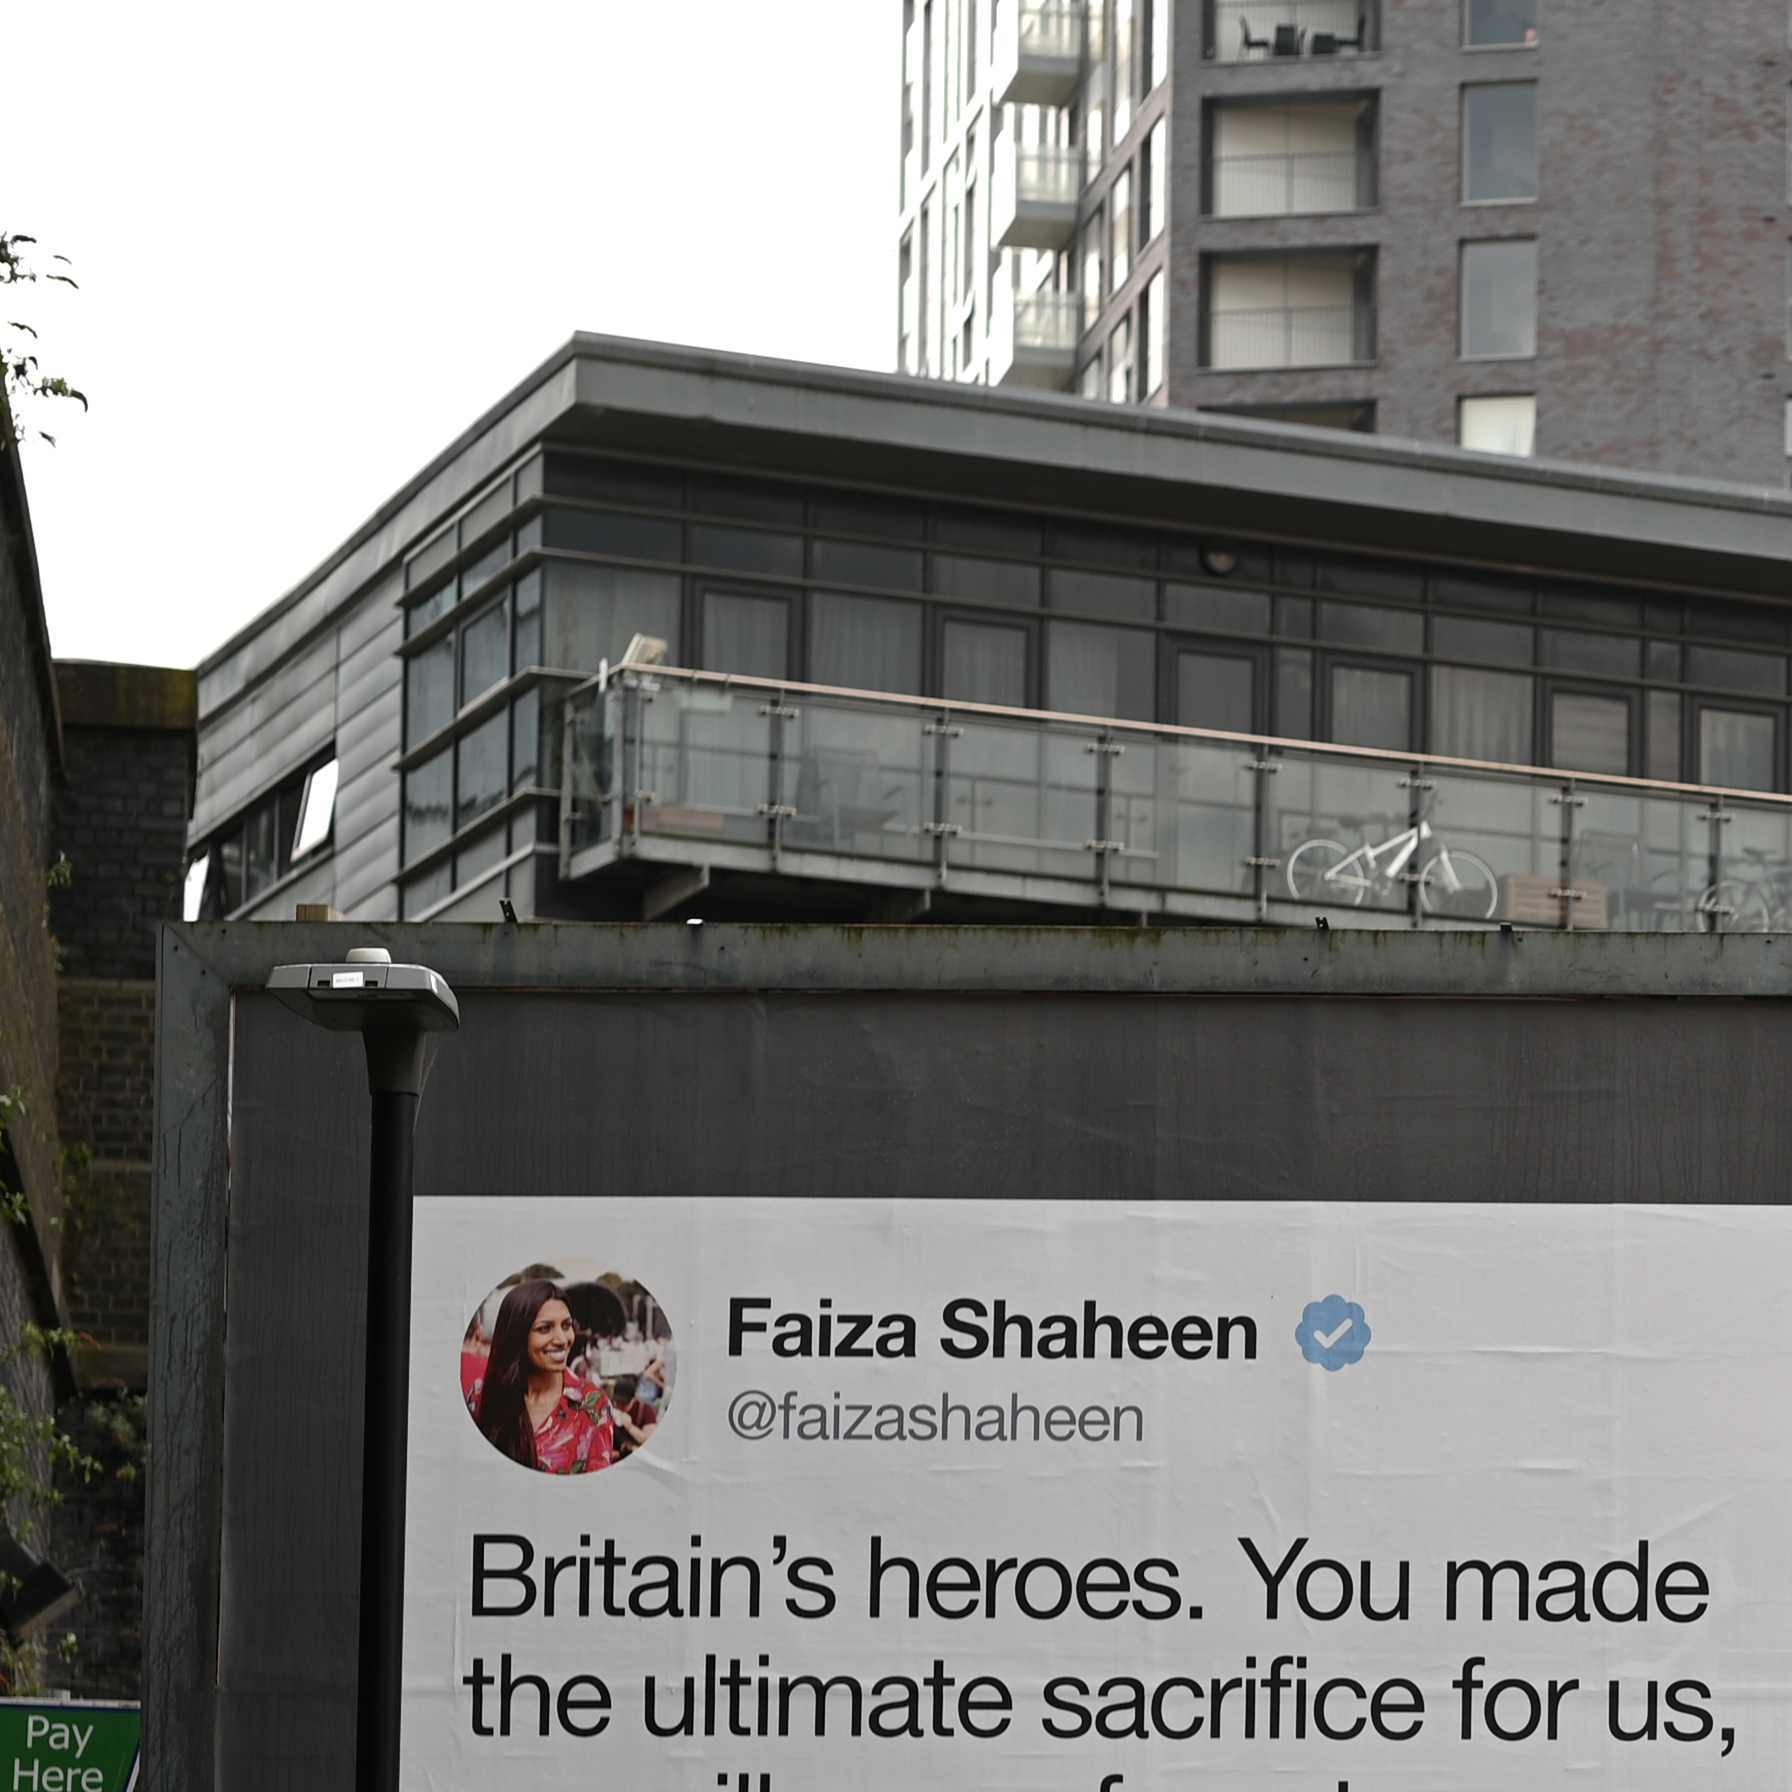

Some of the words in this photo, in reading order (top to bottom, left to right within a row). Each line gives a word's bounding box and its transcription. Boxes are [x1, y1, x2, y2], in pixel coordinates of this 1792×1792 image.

[728, 1297, 917, 1359] Faiza
[940, 1298, 1258, 1361] Shaheen
[728, 1390, 1144, 1442] @faizashaheen
[471, 1533, 838, 1619] Britain’s
[868, 1535, 1204, 1621] heroes.
[1236, 1537, 1411, 1622] You
[1446, 1539, 1711, 1623] made
[26, 1713, 95, 1760] Pay
[462, 1653, 613, 1738] the
[643, 1653, 1014, 1739] ultimate
[1040, 1655, 1426, 1741] sacrifice
[1451, 1656, 1581, 1742] for
[1608, 1679, 1736, 1757] us,
